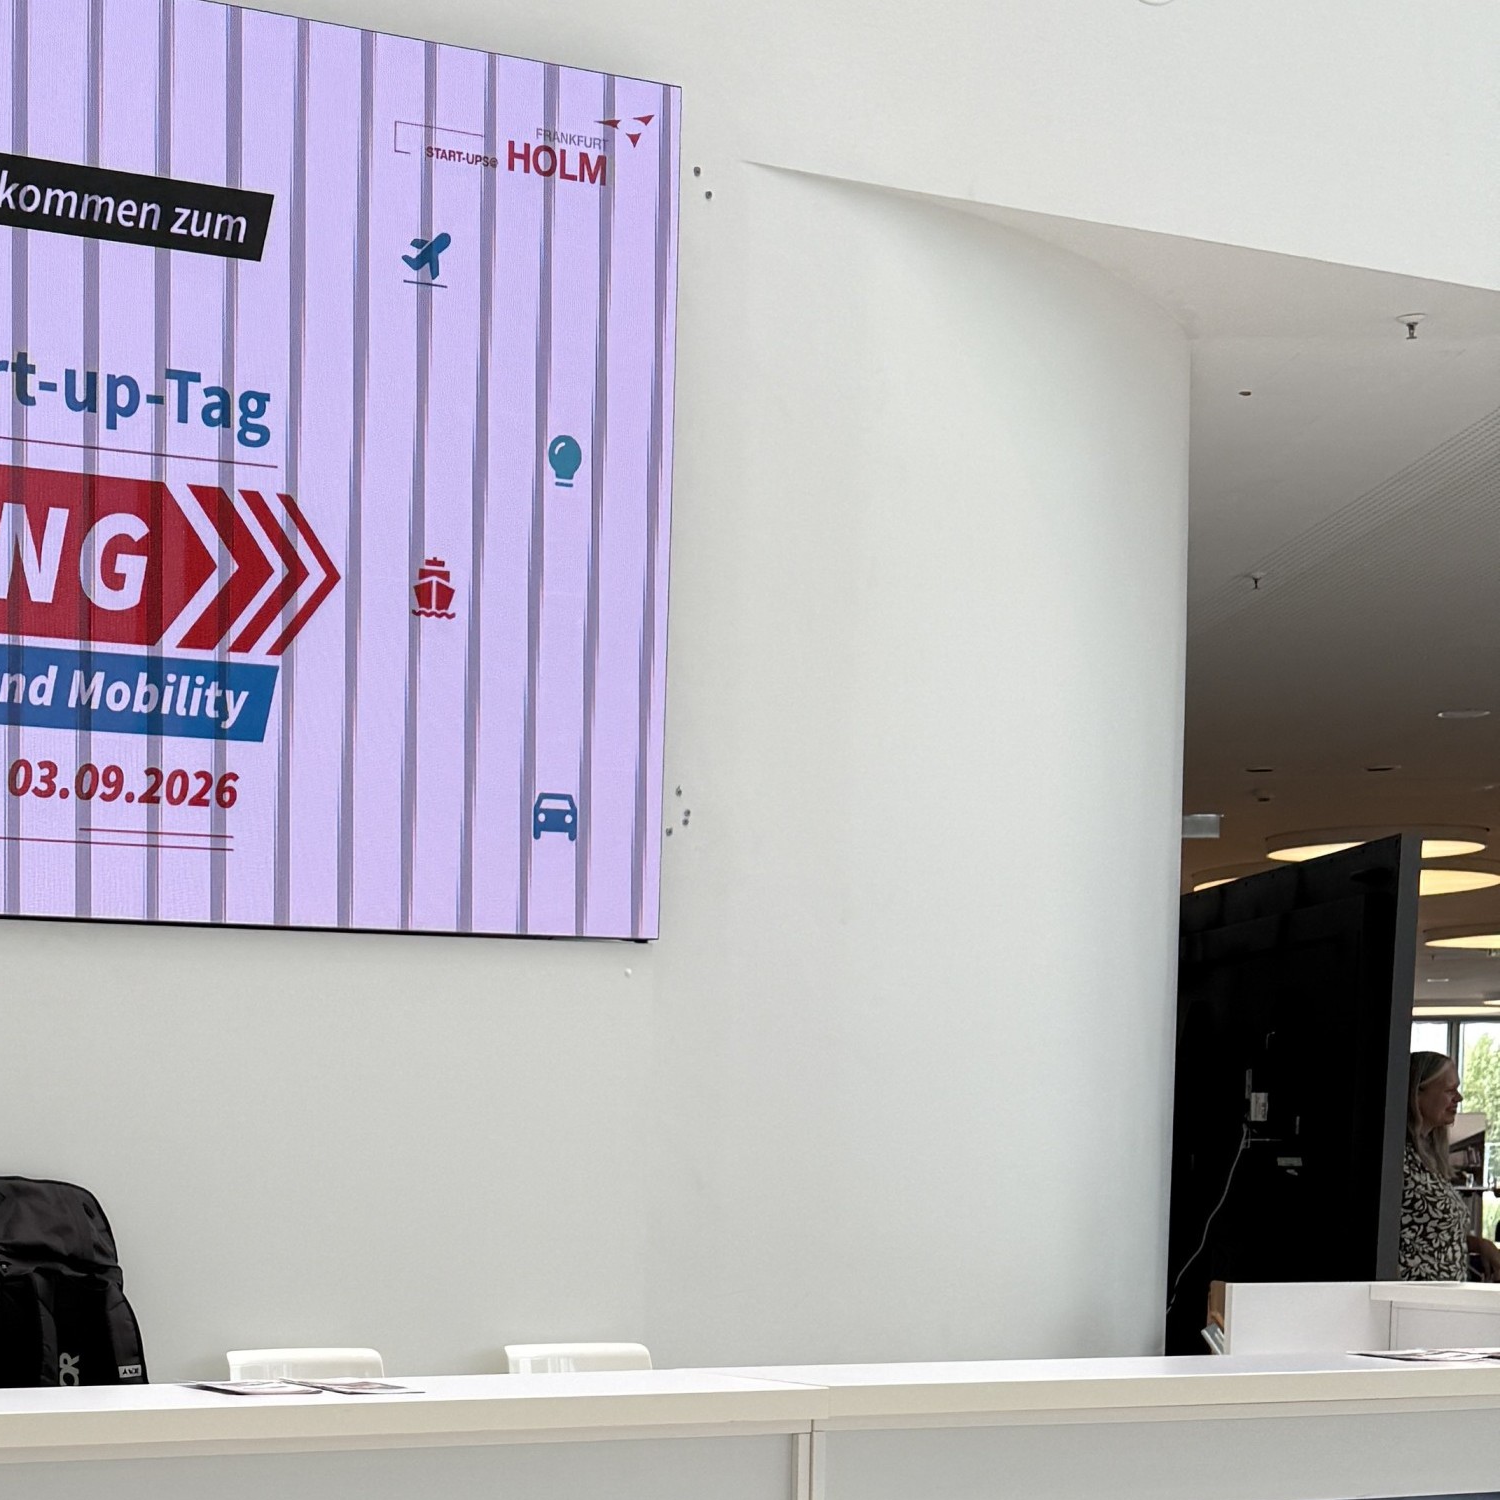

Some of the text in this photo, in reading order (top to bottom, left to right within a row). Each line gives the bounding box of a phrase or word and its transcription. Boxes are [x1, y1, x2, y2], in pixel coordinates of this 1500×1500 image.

[535, 127, 609, 150] FRANKFURT
[507, 139, 608, 187] HOLM
[170, 203, 249, 247] zum
[67, 669, 250, 730] Mobility
[7, 758, 239, 809] 03.09.2026
